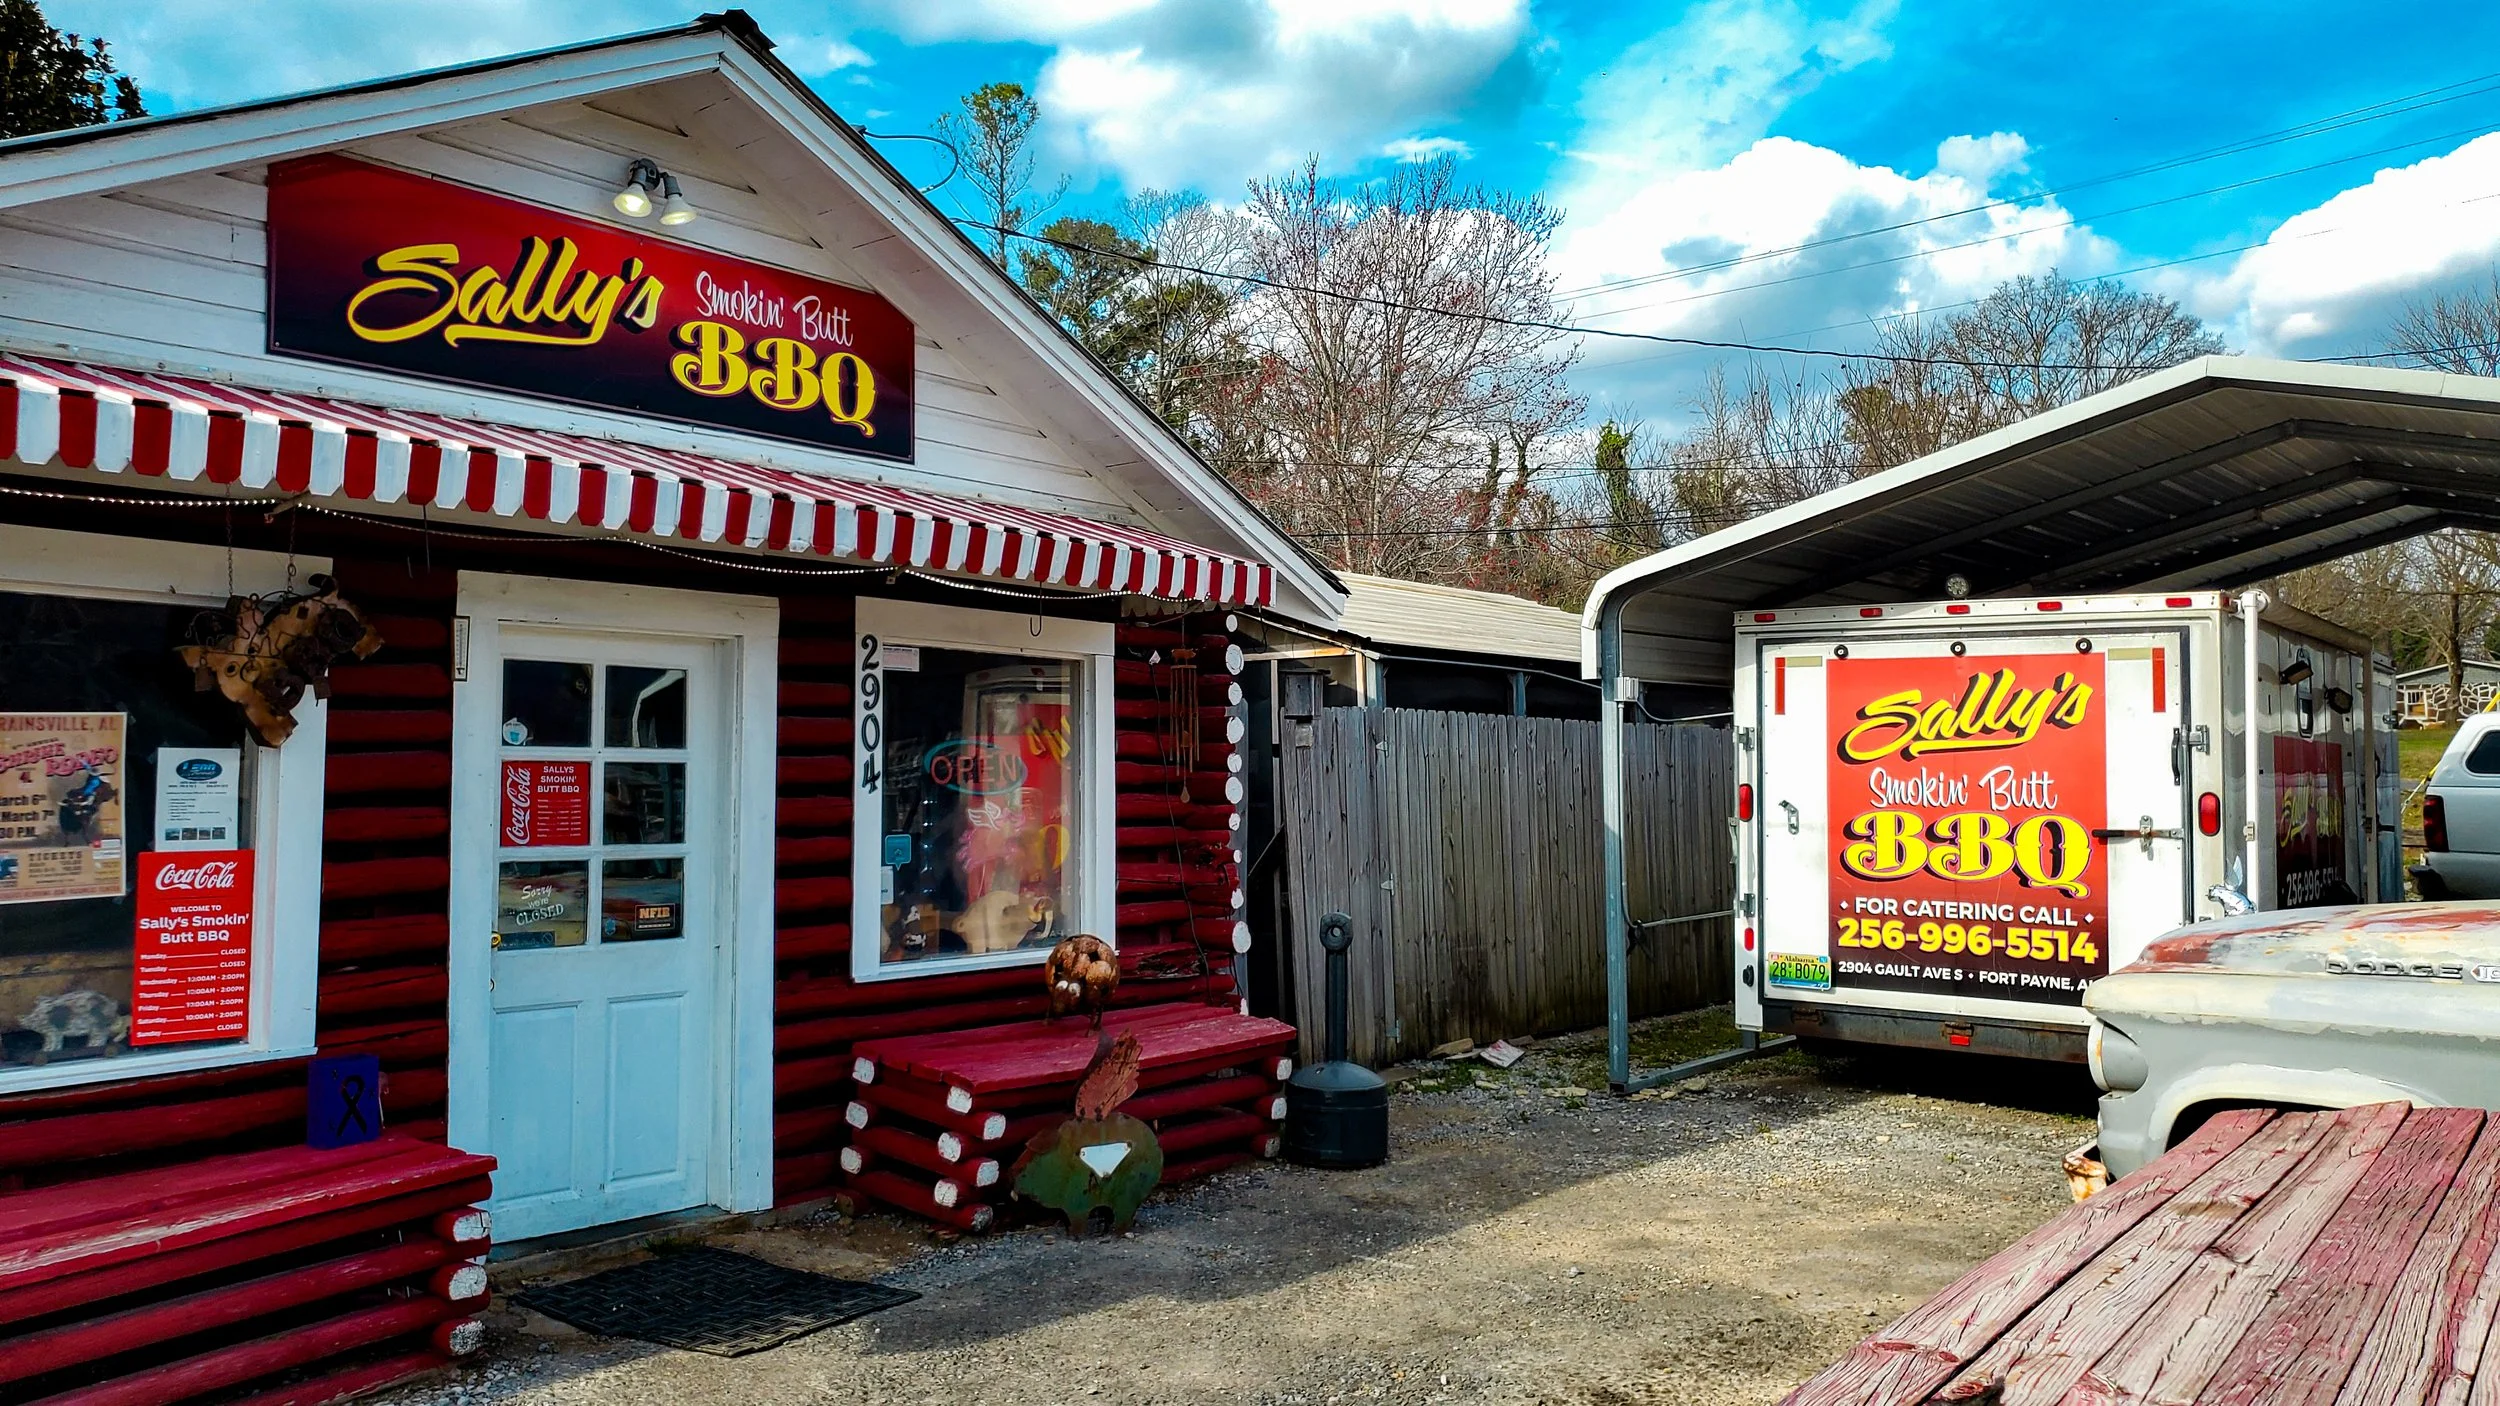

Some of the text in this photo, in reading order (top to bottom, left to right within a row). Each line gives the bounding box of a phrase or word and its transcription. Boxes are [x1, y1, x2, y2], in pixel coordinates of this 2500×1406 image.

[347, 236, 664, 349] Sally's
[696, 270, 855, 347] Smokin' Butt
[670, 319, 877, 438] BBQ
[98, 716, 118, 731] AL
[861, 633, 882, 795] 2904
[1838, 667, 2095, 764] Sally's
[540, 775, 577, 784] SMOKIN'
[543, 765, 575, 774] SALLYS
[930, 753, 1021, 786] OPEN
[537, 785, 580, 793] BUTT BBQ
[1869, 766, 2058, 811] Smokin' Butt
[506, 765, 531, 845] Coca-Cola
[28, 851, 83, 861] TICKETS
[1843, 810, 2093, 899] BBQ
[155, 861, 239, 891] Coca-Cola
[521, 884, 552, 900] Sorry
[170, 904, 222, 913] WELCOME TO
[516, 903, 564, 926] CLOSED
[1855, 896, 2079, 927] FOR CATERING CALL
[140, 912, 249, 931] Sally's Smokin'
[160, 929, 230, 944] Butt BBQ
[1837, 916, 2100, 965] 256-996-5514
[220, 948, 246, 956] CLOSED
[219, 960, 246, 969] CLOSED
[1772, 960, 1788, 978] 28
[2325, 959, 2464, 980] DODGE
[1838, 960, 1873, 975] 2904
[1874, 962, 1921, 978] GAULT
[1922, 966, 1952, 980] AVE
[1953, 968, 1964, 982] S
[1979, 970, 2016, 985] FORT
[2020, 975, 2075, 992] PAYNE,
[216, 1023, 243, 1031] CLOSED
